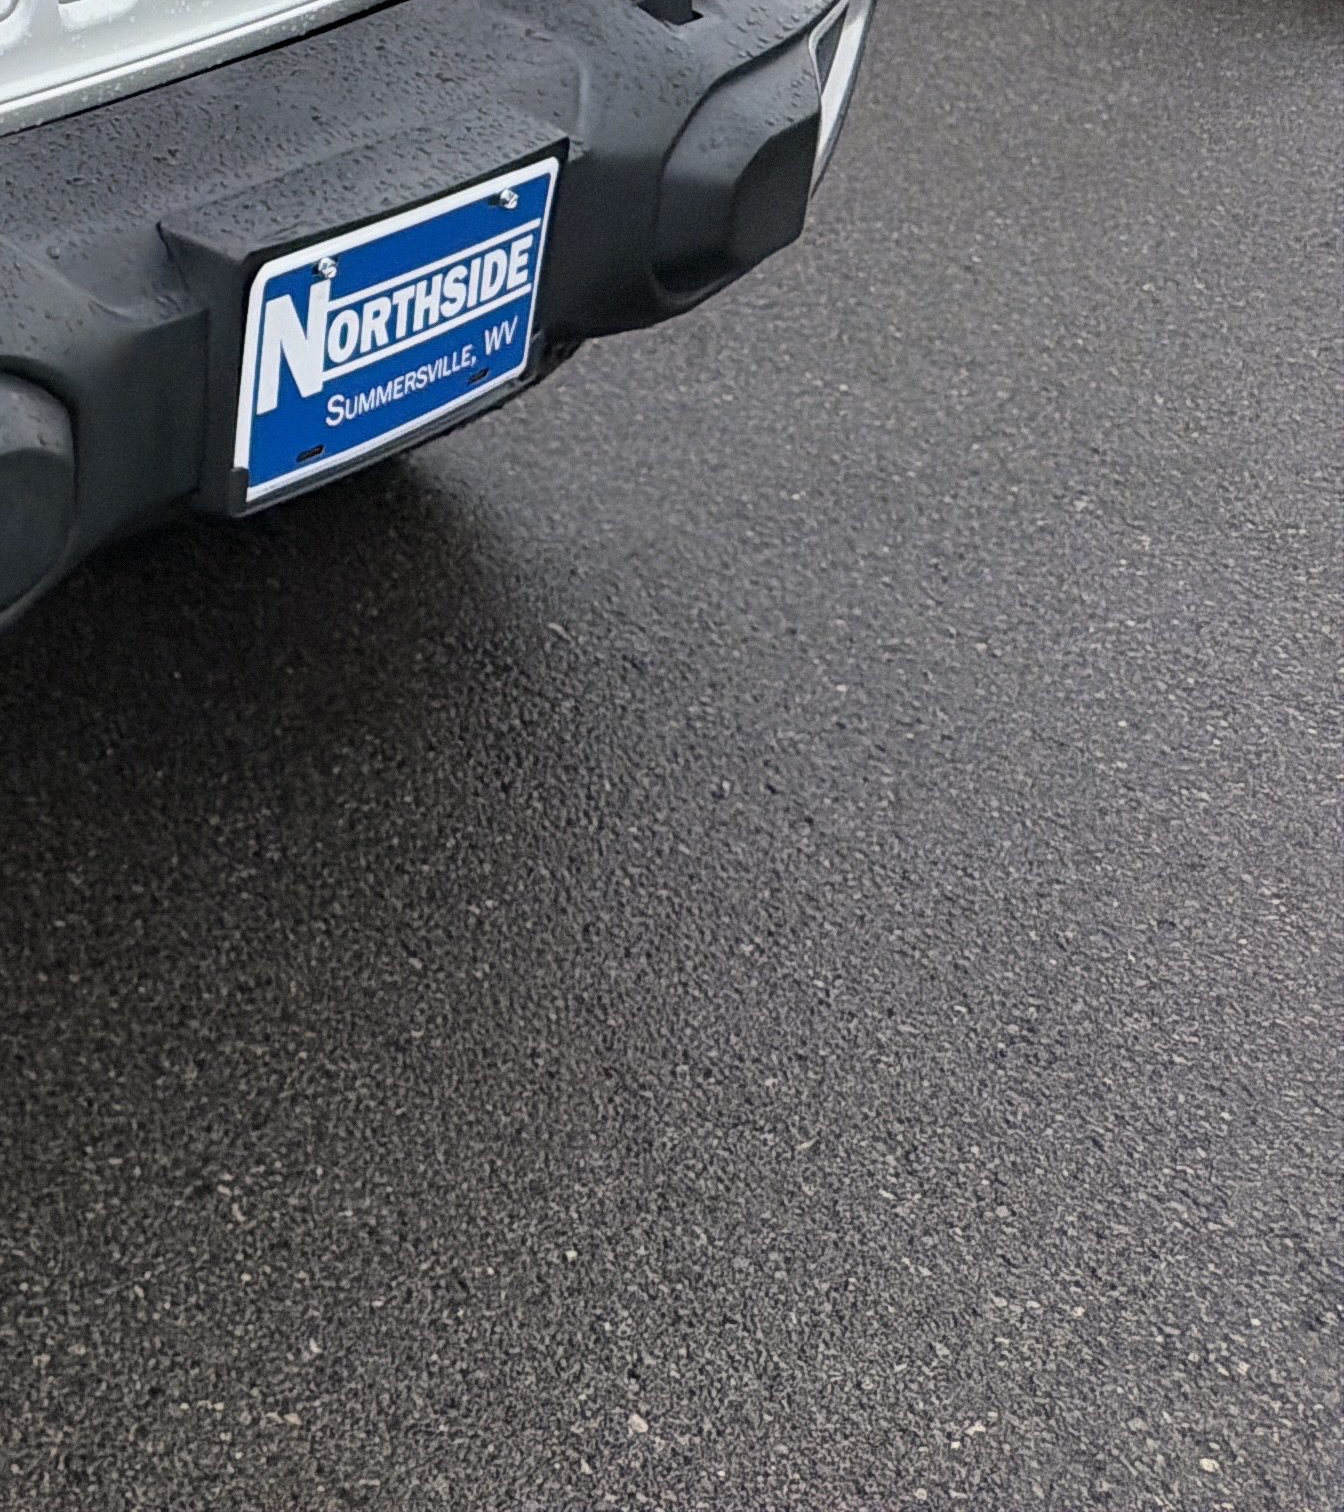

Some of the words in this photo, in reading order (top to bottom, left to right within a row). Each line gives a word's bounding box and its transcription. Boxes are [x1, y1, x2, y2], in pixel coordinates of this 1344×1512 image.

[256, 234, 534, 415] NORTHSIDE
[325, 344, 477, 426] SUMMERSVILLE,
[484, 315, 518, 355] WV
